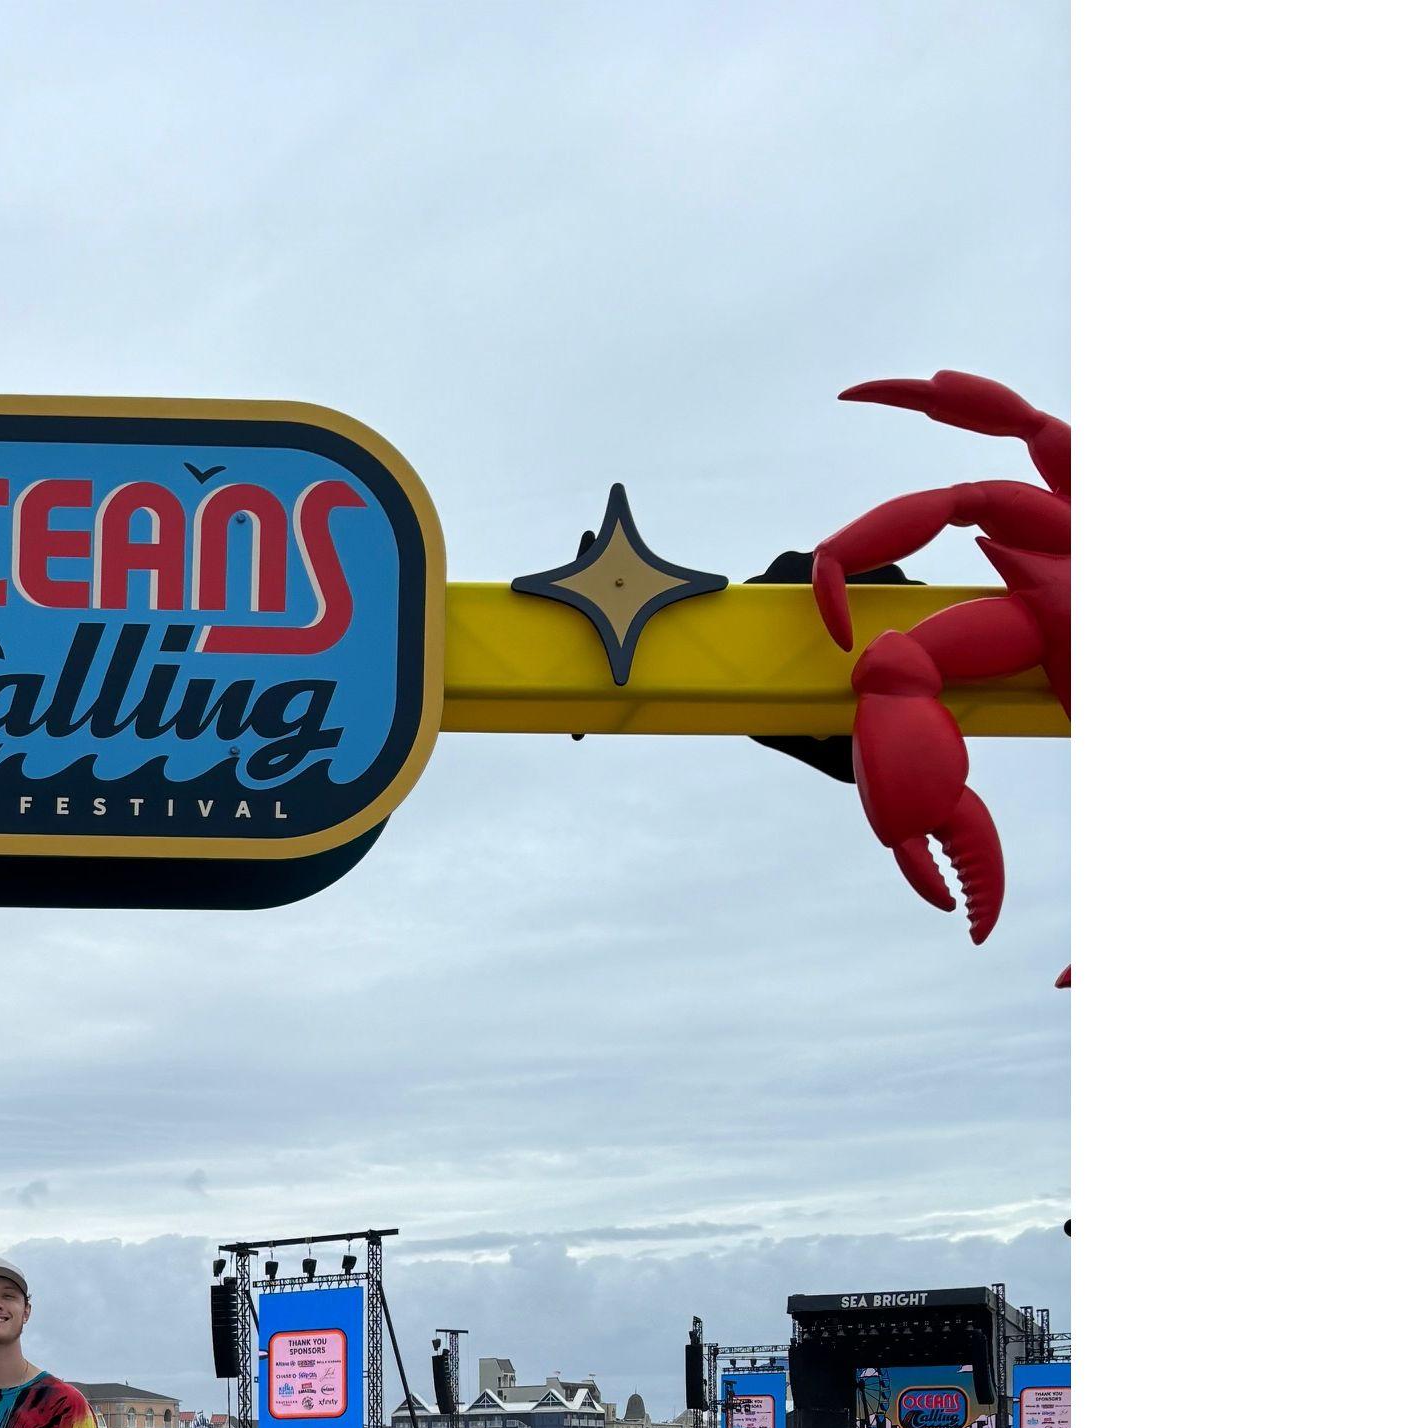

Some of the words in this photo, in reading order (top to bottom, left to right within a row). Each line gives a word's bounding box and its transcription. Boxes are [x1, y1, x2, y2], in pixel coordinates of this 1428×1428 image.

[20, 795, 289, 820] FESTIVAL
[840, 1295, 868, 1308] SEA
[873, 1292, 928, 1307] BRIGHT
[288, 1339, 311, 1347] THANK
[289, 1346, 326, 1355] SPONSORS
[902, 1392, 961, 1413] OCEANS
